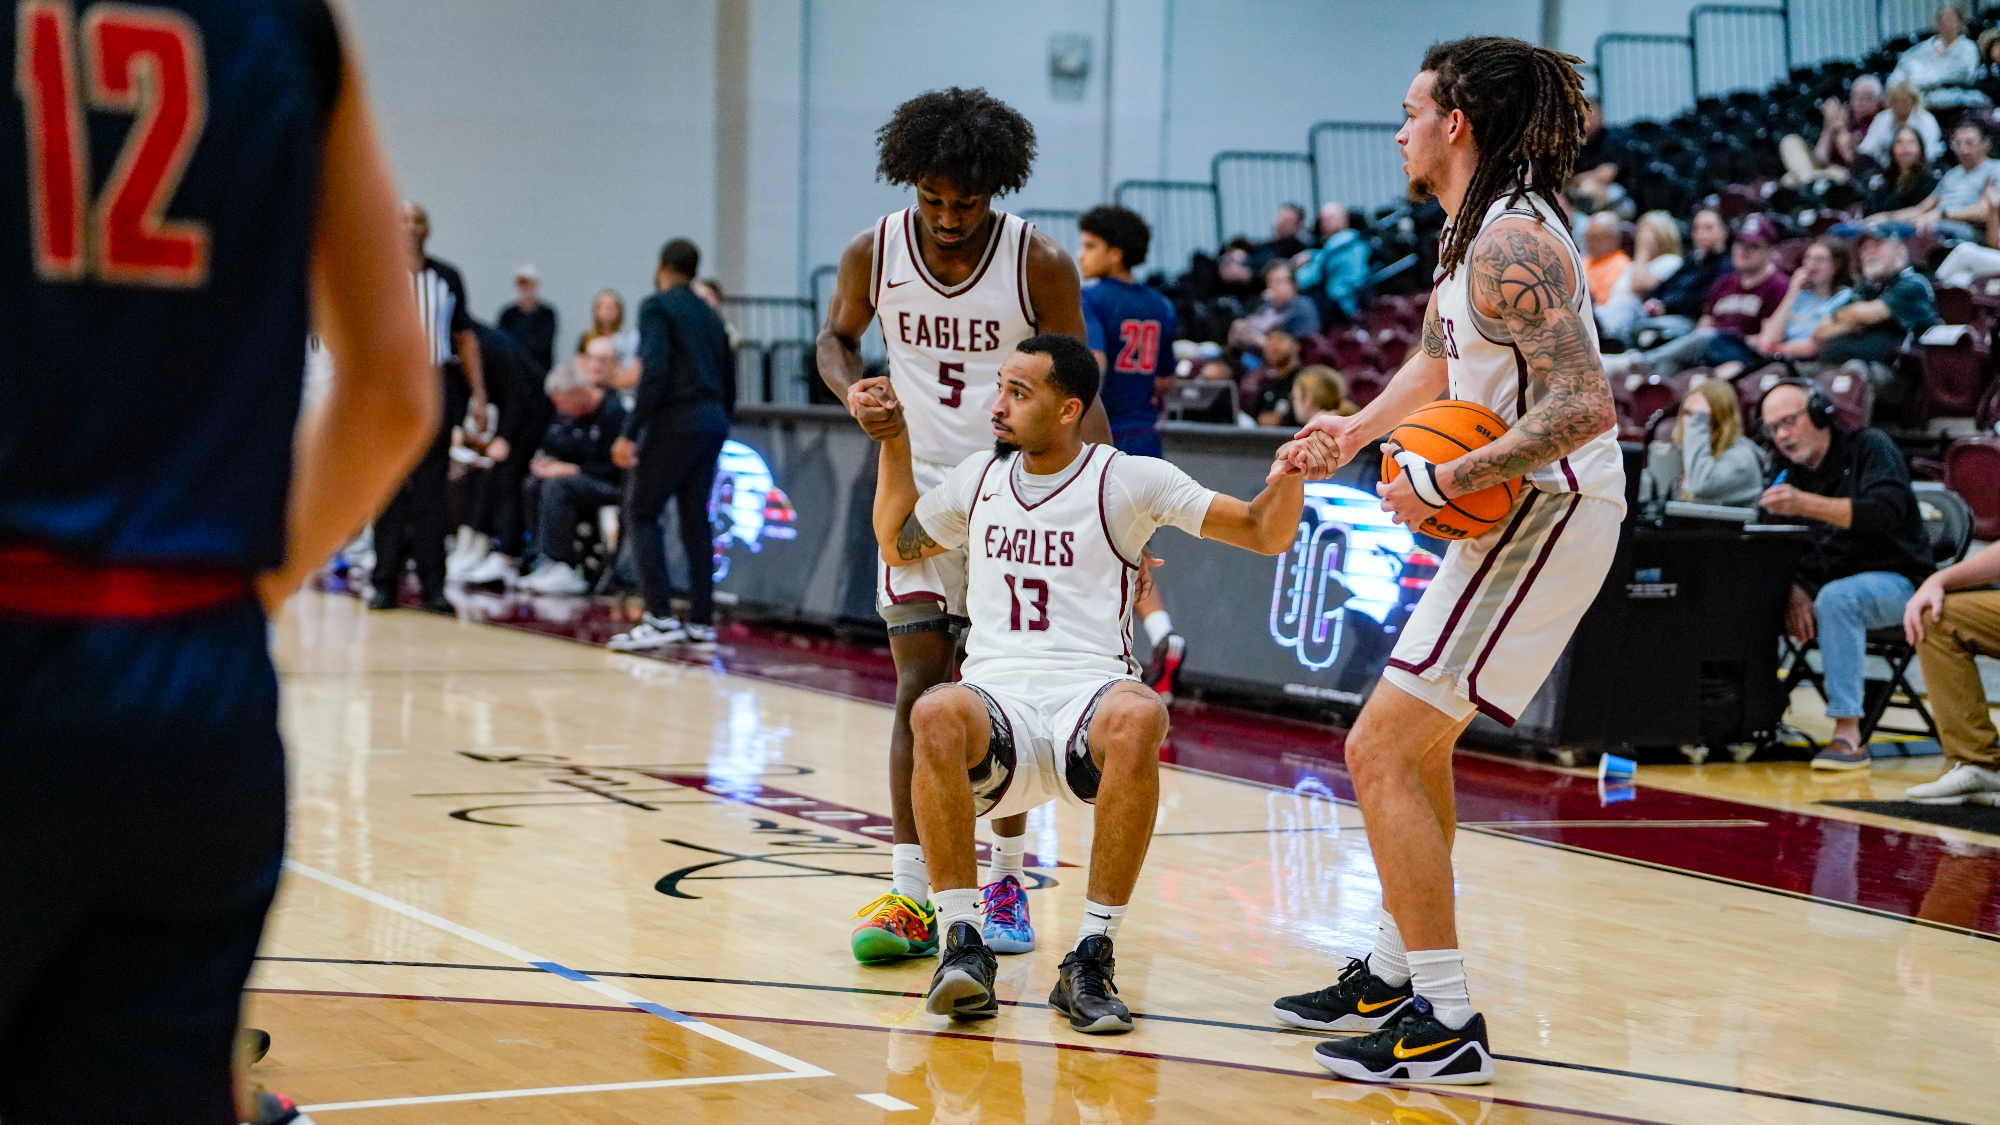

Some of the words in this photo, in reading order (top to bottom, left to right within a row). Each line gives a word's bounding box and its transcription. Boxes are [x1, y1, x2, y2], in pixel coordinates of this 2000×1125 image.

[15, 0, 210, 286] 12
[899, 311, 1000, 352] EAGLES
[1115, 319, 1161, 374] 20
[938, 361, 966, 409] 5
[985, 524, 1075, 567] EAGLES
[1003, 573, 1051, 632] 13
